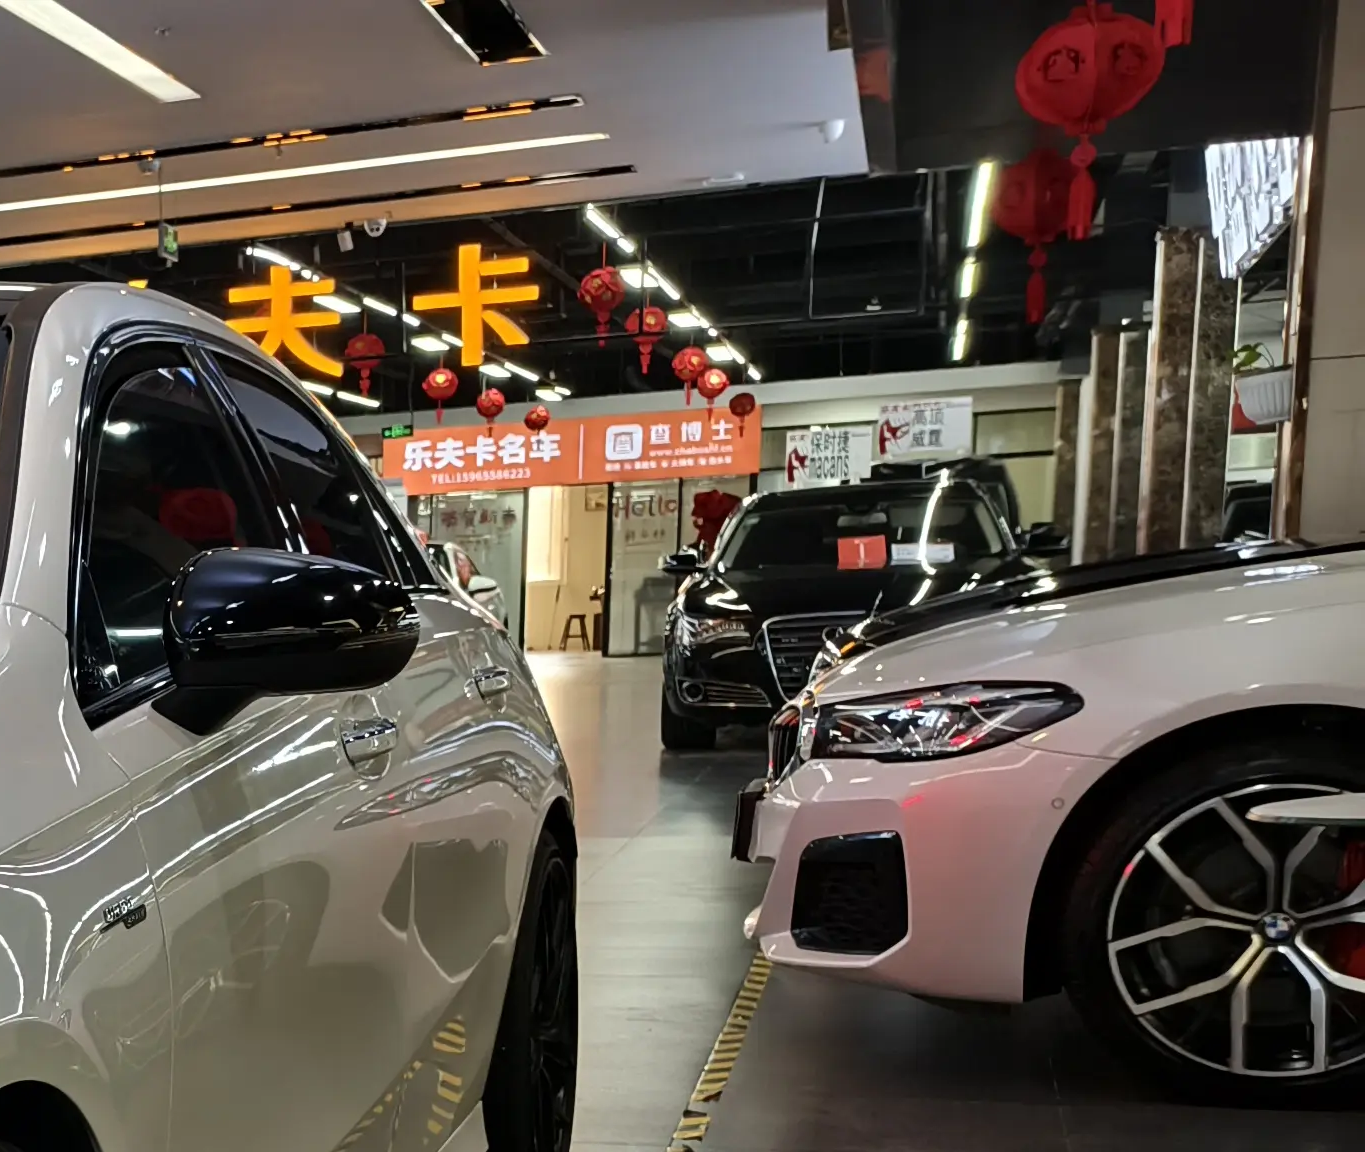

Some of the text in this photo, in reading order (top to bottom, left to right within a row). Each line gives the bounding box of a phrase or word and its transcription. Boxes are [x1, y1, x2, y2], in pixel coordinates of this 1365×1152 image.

[649, 418, 734, 445] 查博士
[402, 430, 562, 472] 乐夫卡名车
